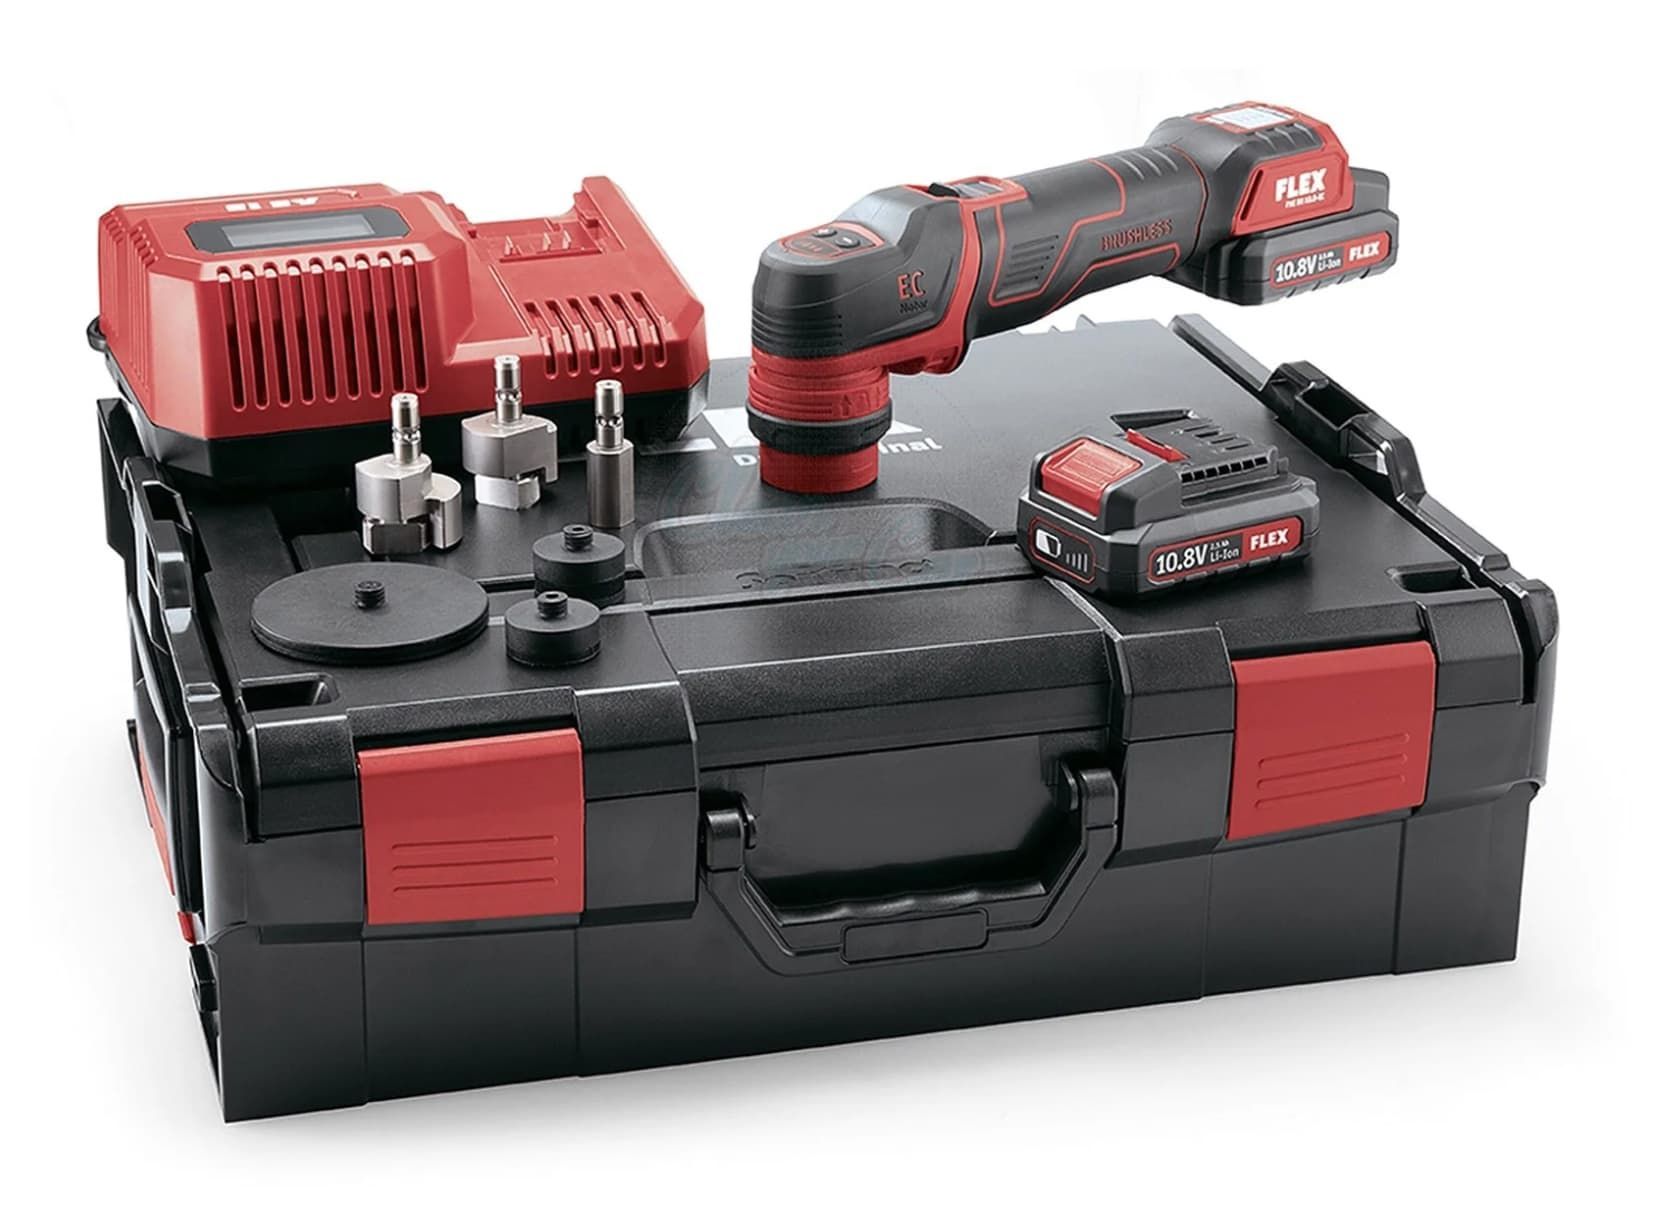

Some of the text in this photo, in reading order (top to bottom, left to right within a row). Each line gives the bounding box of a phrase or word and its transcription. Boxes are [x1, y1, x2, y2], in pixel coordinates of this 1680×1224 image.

[1275, 168, 1327, 202] FLEX
[1099, 217, 1172, 251] BRUSHLESS
[1348, 241, 1380, 262] FLEX
[1275, 255, 1317, 282] 10.8V
[897, 271, 926, 300] EC
[1250, 528, 1289, 551] FLEX
[1156, 544, 1208, 576] 10.8V
[1210, 548, 1240, 563] Li-Ion
